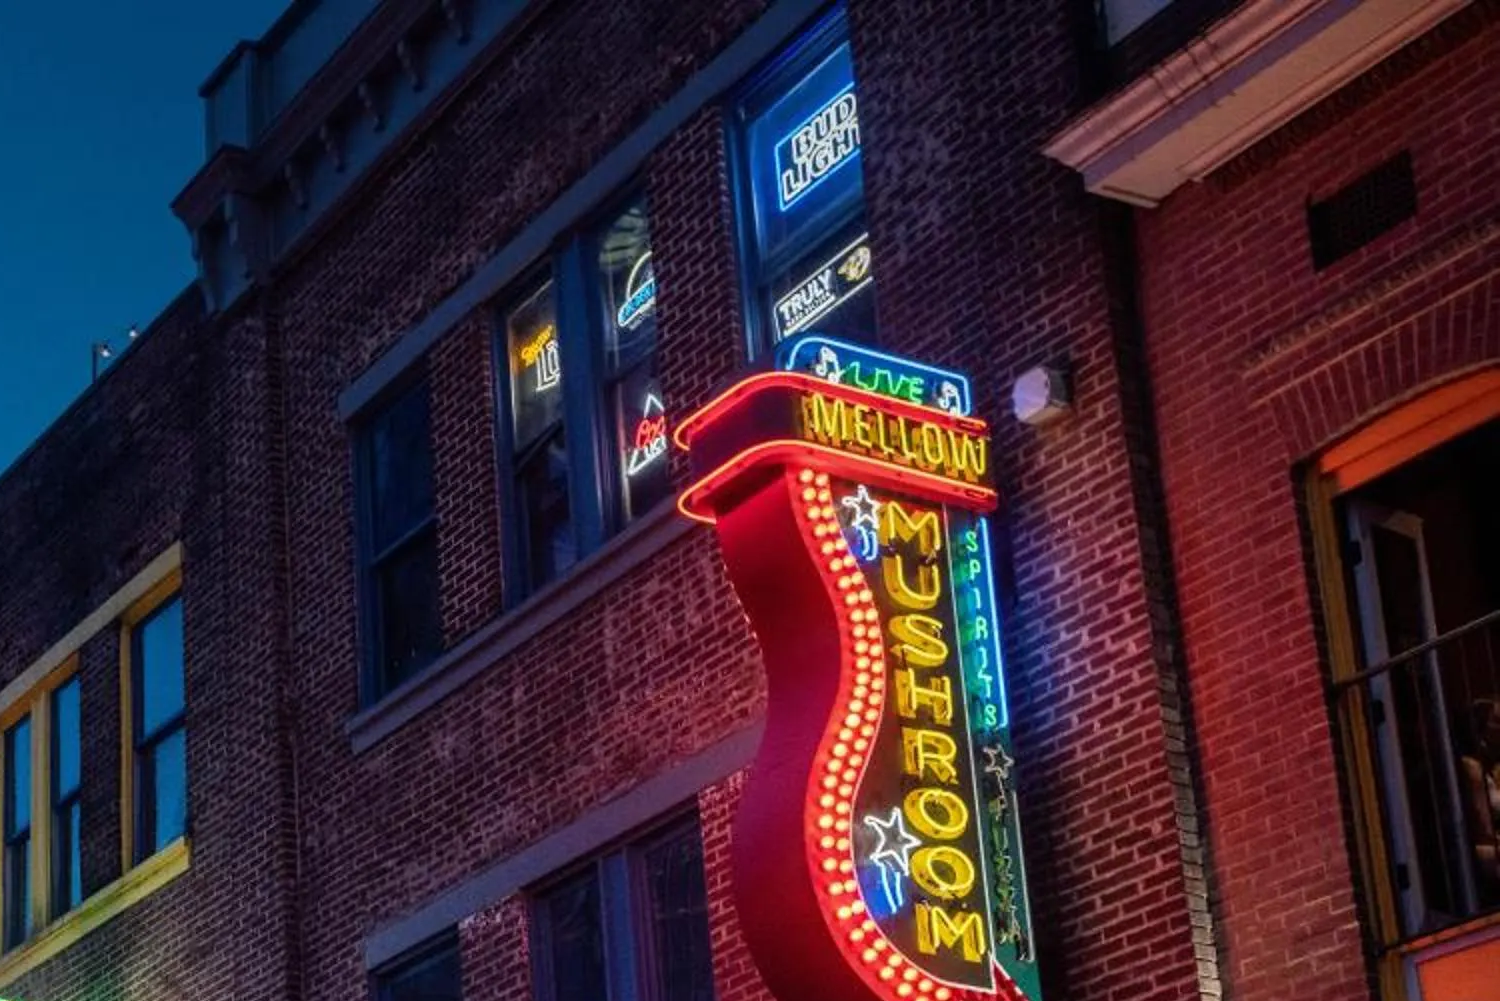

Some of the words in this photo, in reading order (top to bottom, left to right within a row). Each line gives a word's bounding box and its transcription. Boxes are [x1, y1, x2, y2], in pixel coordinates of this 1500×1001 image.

[792, 93, 857, 164] BUD
[779, 269, 832, 320] TRULY
[846, 361, 925, 404] LIVE
[804, 391, 987, 480] MELLOW
[966, 530, 997, 727] SPIRITS
[878, 501, 986, 962] MUSHROOM
